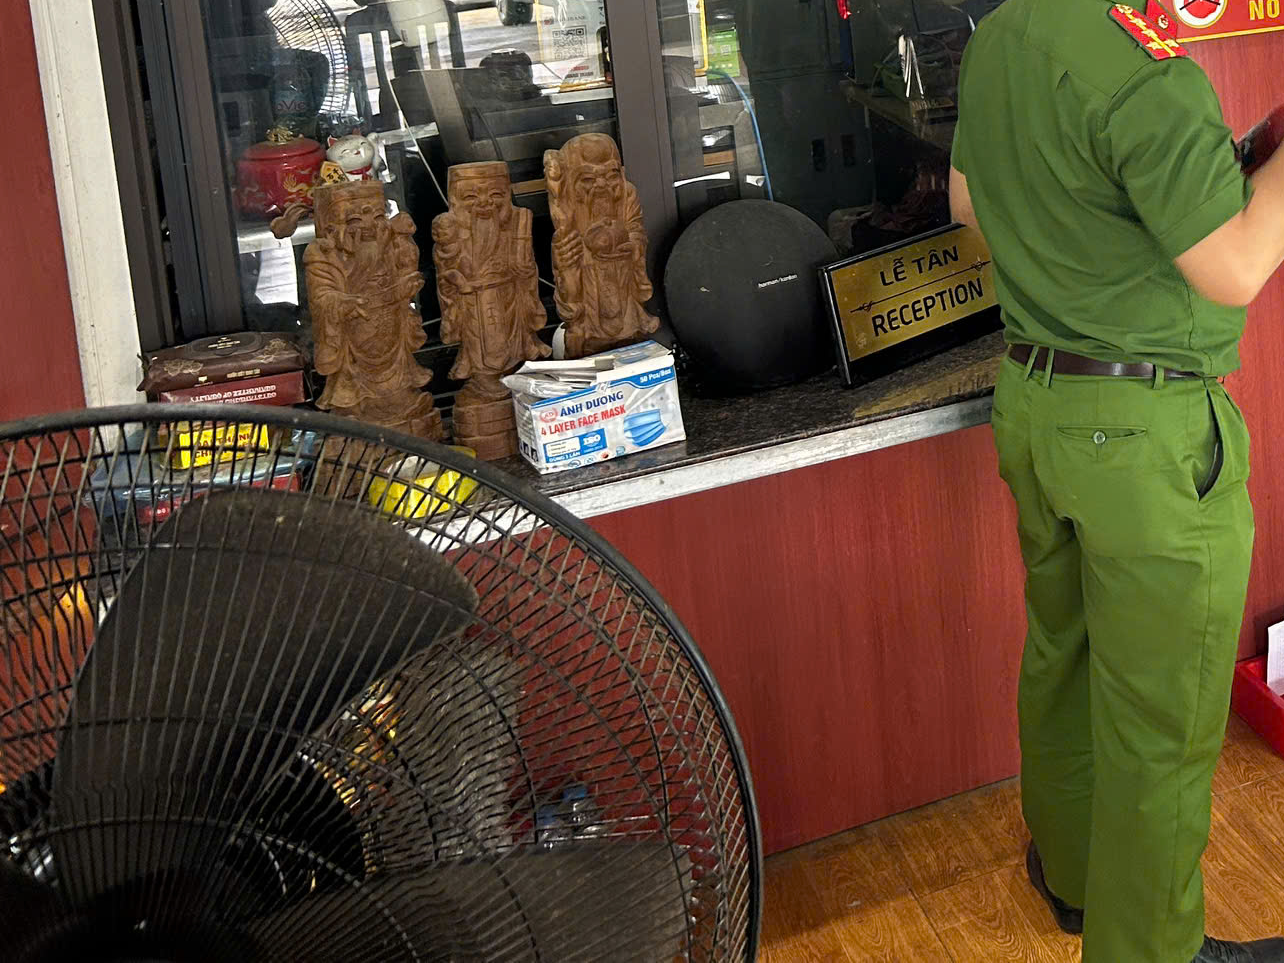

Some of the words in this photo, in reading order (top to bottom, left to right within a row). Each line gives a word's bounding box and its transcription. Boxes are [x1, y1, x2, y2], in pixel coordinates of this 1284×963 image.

[879, 256, 907, 286] LỄ
[911, 244, 959, 274] TÂN
[871, 276, 984, 337] RECEPTION
[541, 426, 547, 436] 4
[548, 420, 577, 435] LAYER
[577, 412, 600, 427] FACE
[600, 404, 627, 421] MASK
